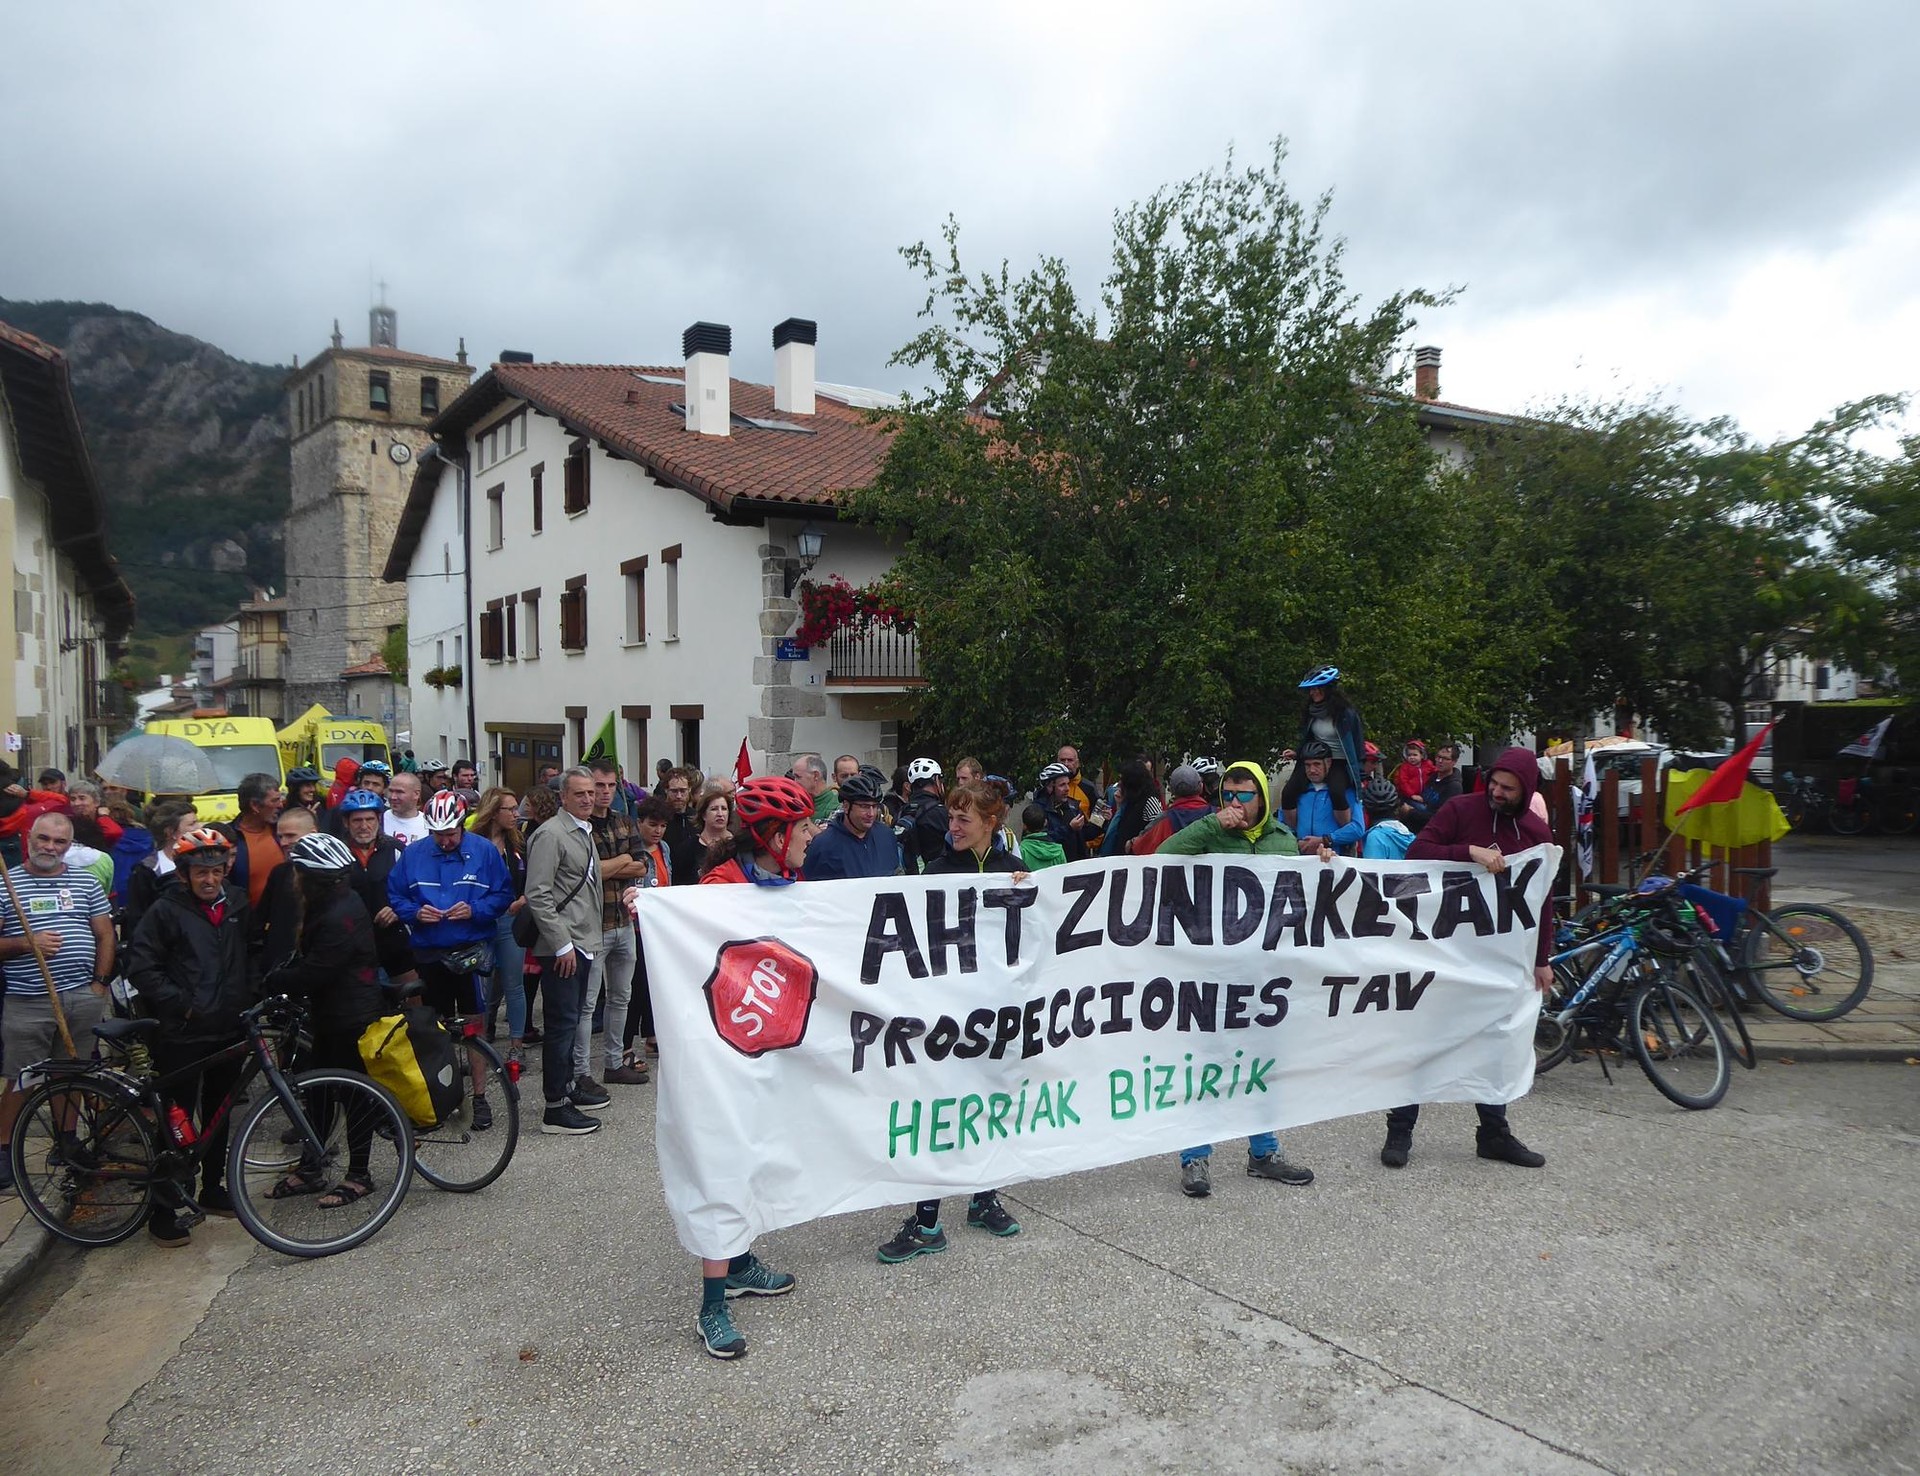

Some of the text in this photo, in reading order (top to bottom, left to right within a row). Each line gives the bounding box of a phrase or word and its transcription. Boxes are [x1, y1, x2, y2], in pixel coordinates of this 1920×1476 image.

[810, 675, 815, 684] 1
[184, 722, 239, 736] DYA
[331, 730, 375, 740] DYA
[860, 858, 1543, 985] AHT ZUNDAKETAK
[730, 957, 788, 1037] STOP
[850, 971, 1435, 1073] PROSPECCIONES TAV
